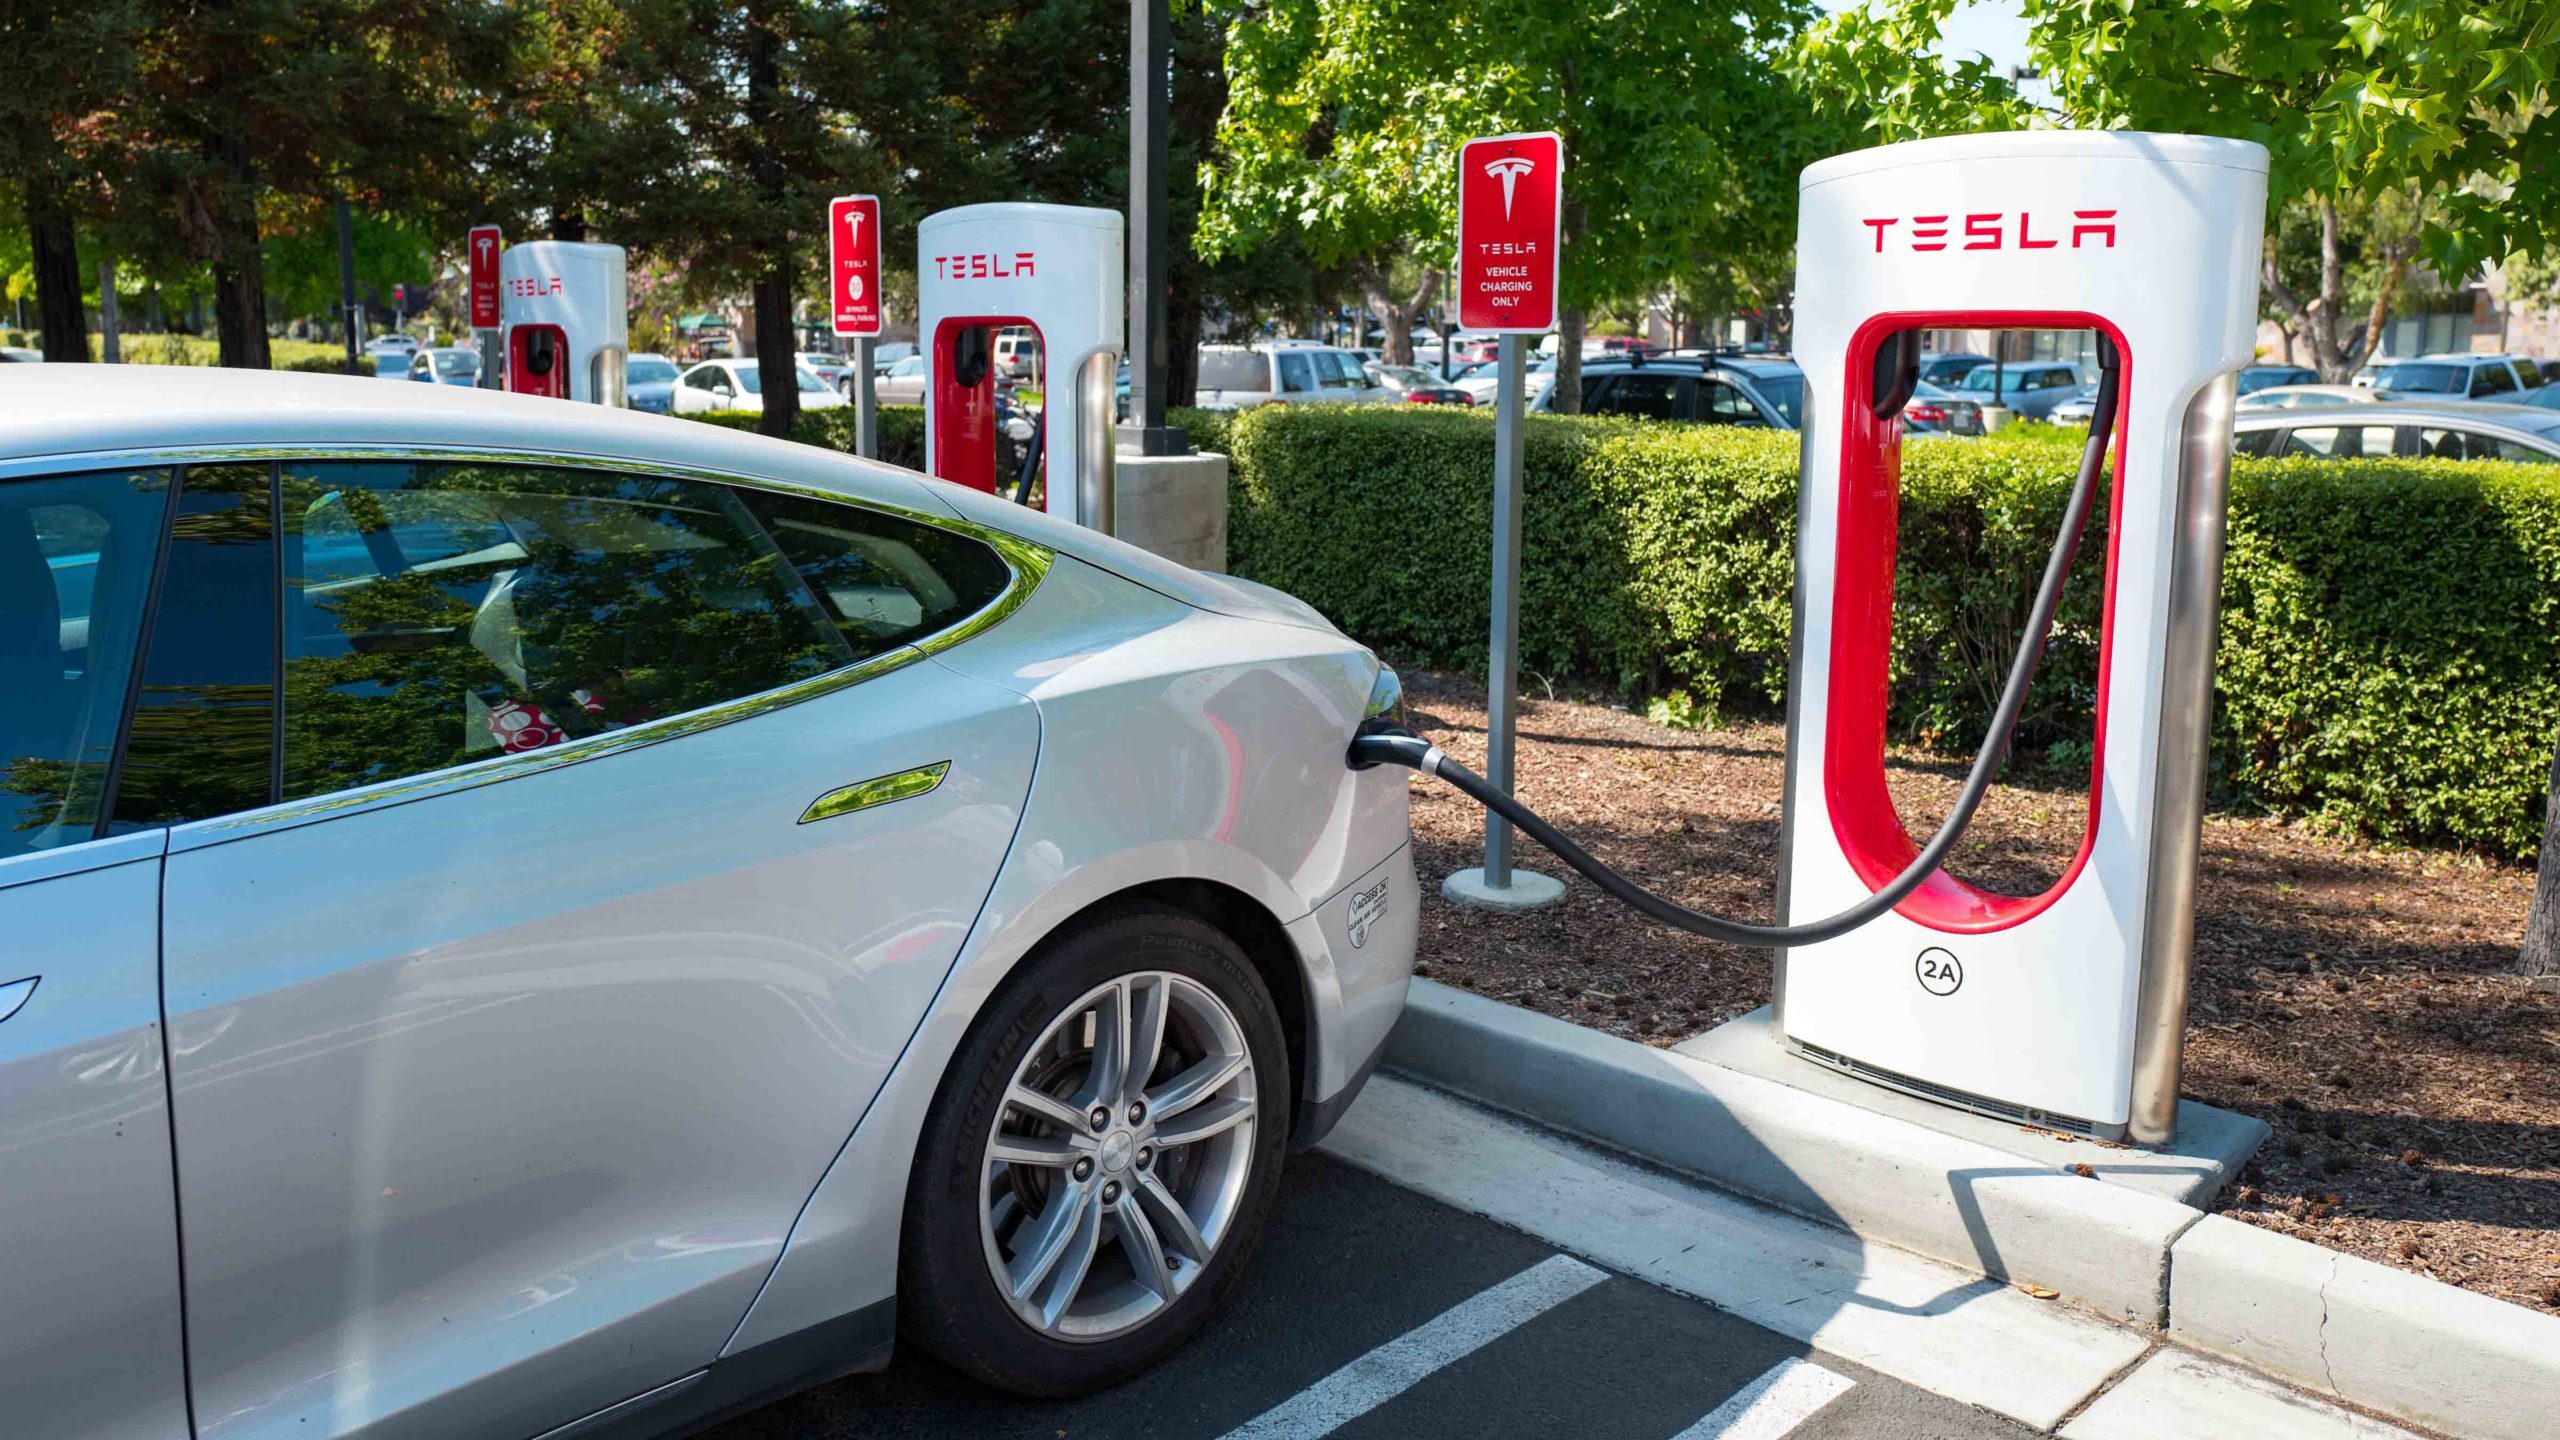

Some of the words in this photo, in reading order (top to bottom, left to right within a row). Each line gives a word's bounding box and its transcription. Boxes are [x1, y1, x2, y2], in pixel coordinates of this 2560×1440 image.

[1862, 210, 2118, 252] TESLA
[1480, 242, 1536, 255] TESLA
[844, 260, 868, 268] TESLA
[935, 253, 1035, 280] TESLA
[1486, 266, 1528, 277] VEHICLE
[508, 278, 562, 297] TESLA
[1480, 281, 1533, 292] CHARGING
[1492, 296, 1520, 307] ONLY
[1358, 887, 1378, 909] ACCESS
[1924, 960, 1956, 982] 2A
